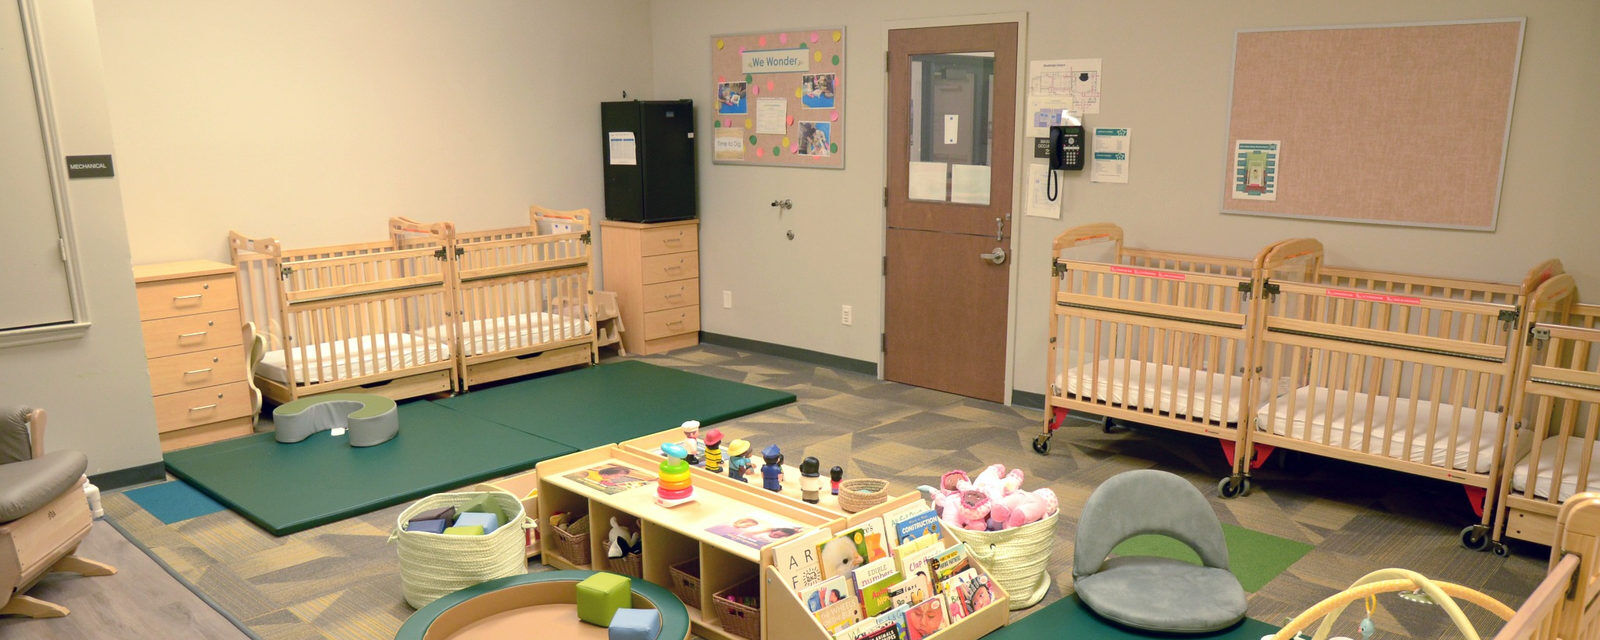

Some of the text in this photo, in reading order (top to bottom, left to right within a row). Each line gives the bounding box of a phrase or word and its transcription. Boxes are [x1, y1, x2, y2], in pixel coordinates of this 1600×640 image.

[752, 56, 798, 67] We Wonder
[902, 515, 938, 534] CONSTRUCTION
